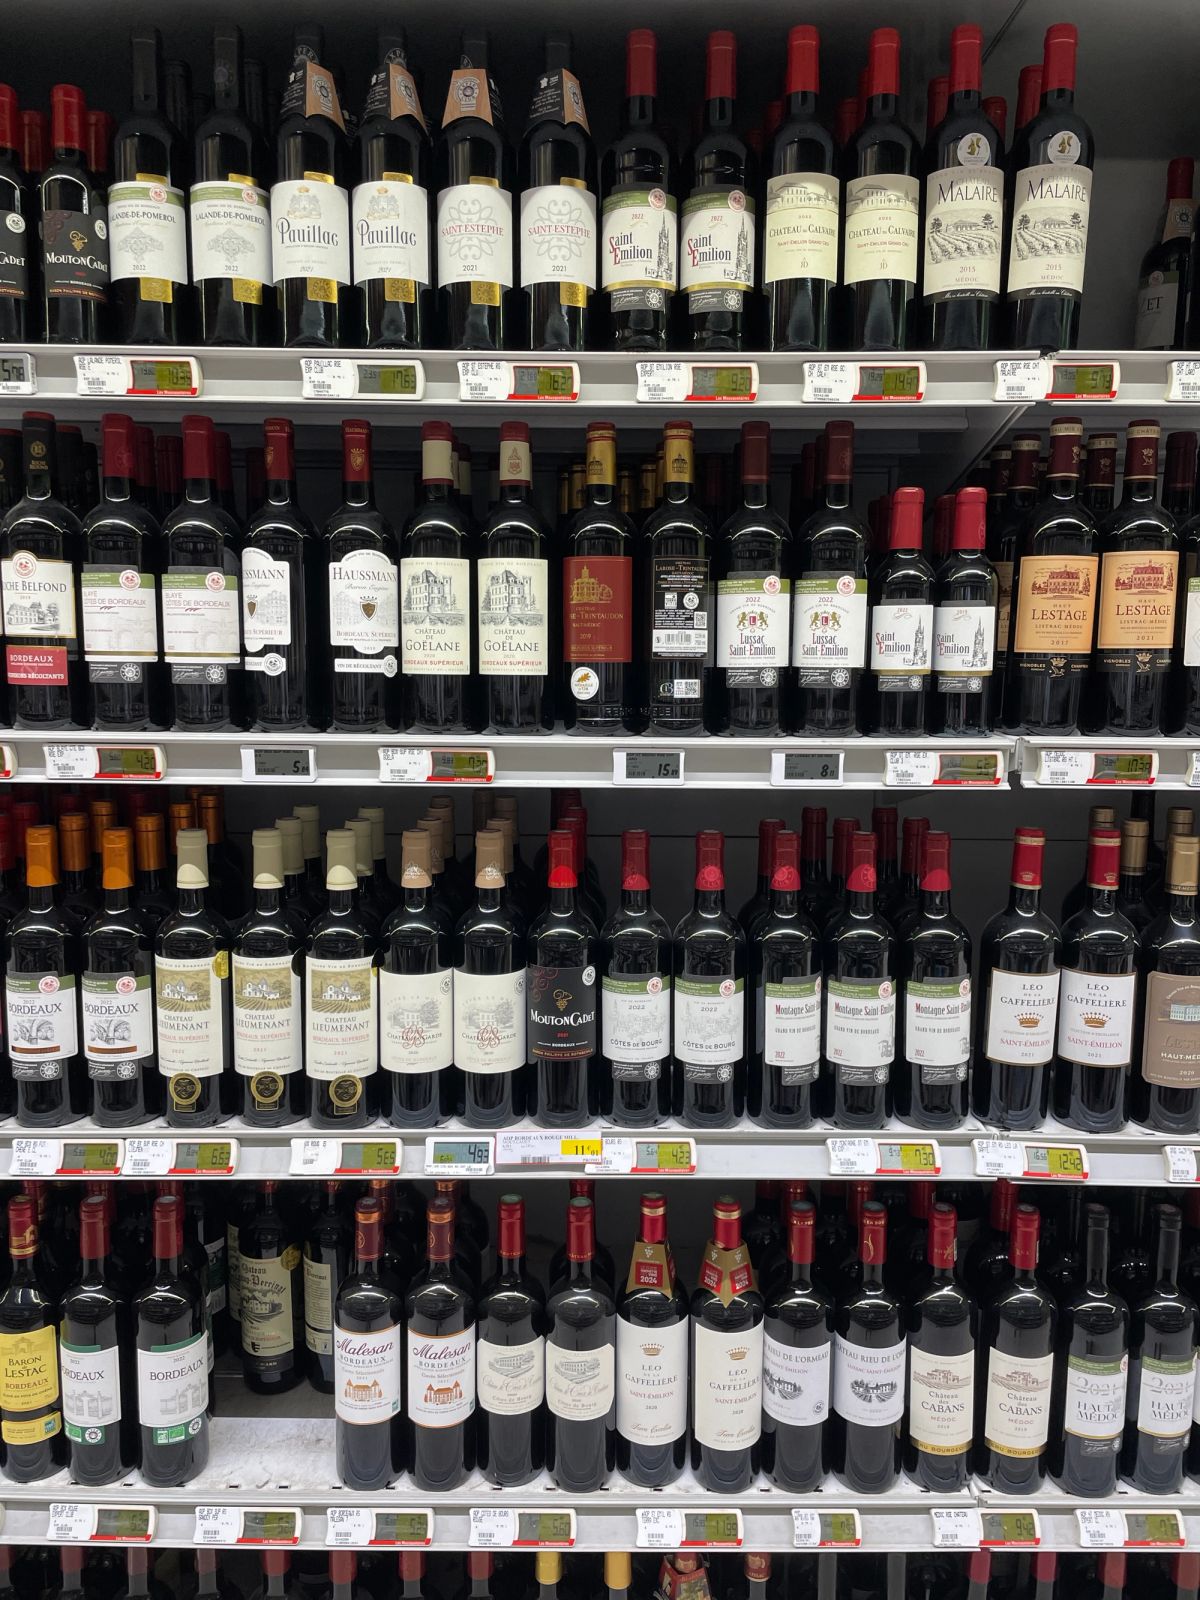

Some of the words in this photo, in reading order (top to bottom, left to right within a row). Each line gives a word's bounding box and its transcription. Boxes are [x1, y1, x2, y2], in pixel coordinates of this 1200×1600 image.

[938, 181, 998, 204] MALAIRE
[1027, 178, 1086, 201] MALAIRE
[276, 217, 338, 246] Pauillac
[357, 219, 416, 246] Pauillac
[609, 232, 632, 255] Saint
[688, 234, 711, 255] Saint
[614, 246, 652, 265] Emilion
[692, 249, 731, 267] Emilion
[22, 582, 67, 592] BELFOND
[1032, 609, 1087, 620] LESTAGE
[1116, 604, 1170, 616] LESTAGE
[406, 638, 460, 651] GOËLANE
[740, 633, 764, 645] Lussac
[812, 633, 836, 645] Lussac
[876, 633, 894, 645] Saint
[484, 640, 539, 651] GOËLANE
[730, 644, 775, 656] Saint-Emilion
[802, 644, 848, 656] Saint-Emilion
[879, 642, 910, 654] Emilion
[940, 643, 970, 655] Emilion
[9, 1003, 62, 1014] BORDEAUX
[85, 1003, 138, 1013] BORDEAUX
[834, 1002, 862, 1016] Montagne
[916, 1003, 944, 1015] Montagne
[531, 1008, 570, 1026] MOUTON
[570, 1012, 594, 1026] CADET
[236, 1019, 290, 1029] LIEUMENANT
[313, 1021, 369, 1032] LIEUMENANT
[611, 1038, 631, 1046] CÔTES
[642, 1039, 662, 1047] BOURG
[682, 1040, 703, 1049] CÔTES
[714, 1040, 736, 1049] BOURG
[1068, 1036, 1122, 1048] SAINT-ÉMILION
[336, 1338, 394, 1355] Malesan
[413, 1342, 471, 1360] Malesan
[9, 1356, 41, 1366] BARON
[340, 1355, 386, 1363] BORDEAUX
[419, 1356, 467, 1369] BORDEAUX
[783, 1354, 793, 1362] DE
[5, 1364, 46, 1377] LESTAC
[150, 1358, 203, 1380] BORDEAUX
[6, 1378, 48, 1389] BORDEAUX
[922, 1401, 964, 1413] CABANS
[999, 1402, 1042, 1415] CABANS
[1078, 1401, 1112, 1411] HAUT
[1152, 1401, 1183, 1411] HAUT
